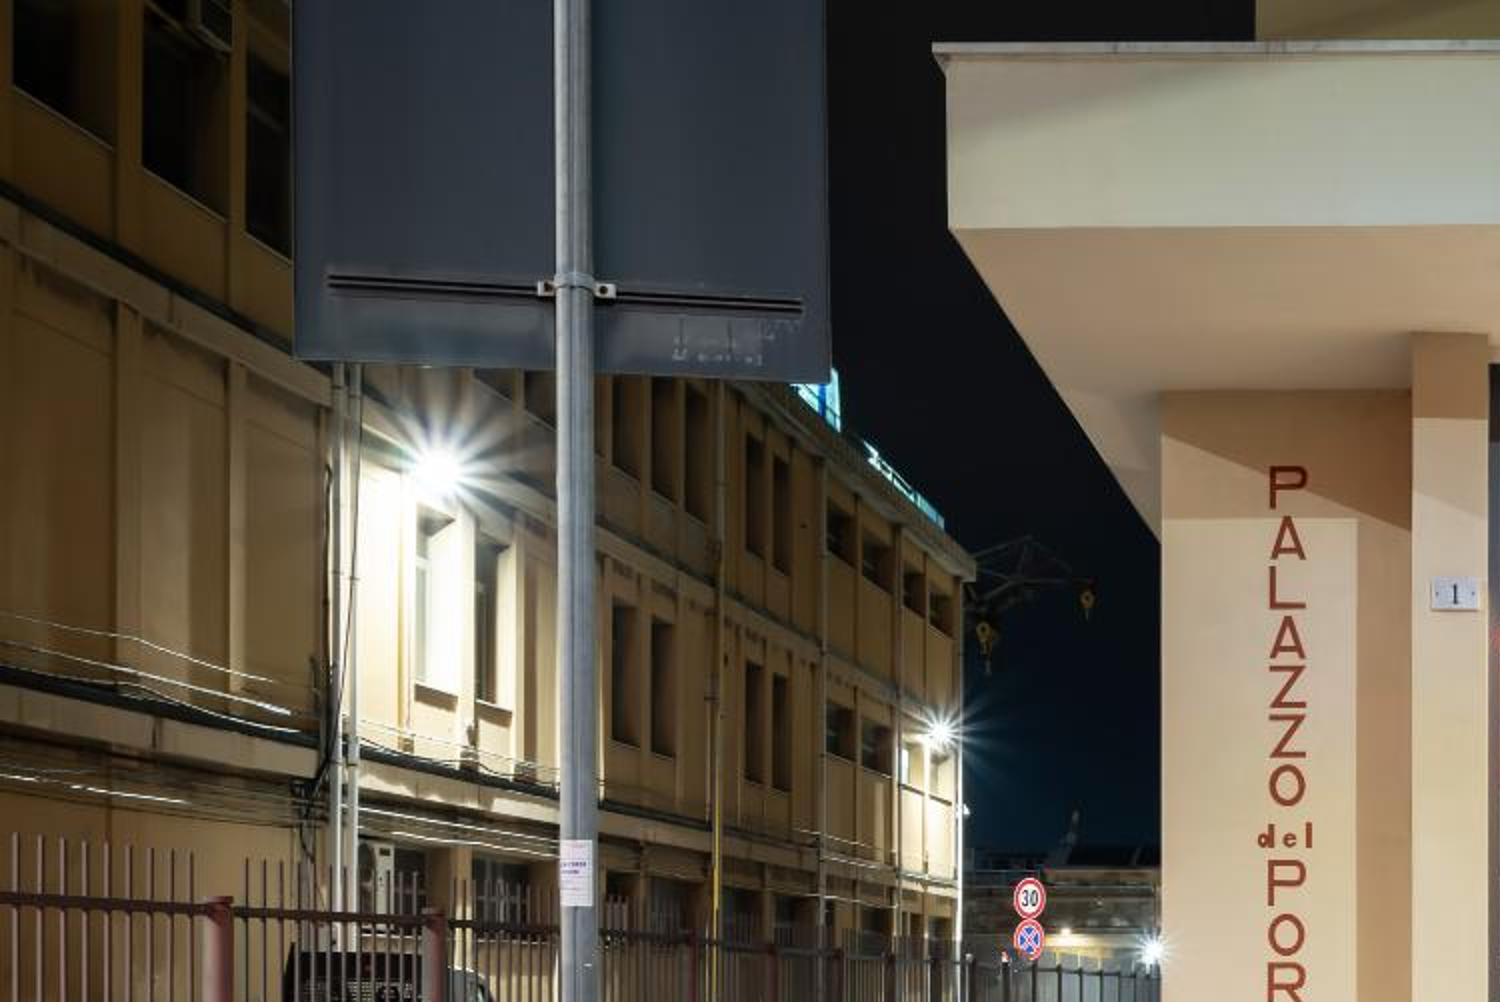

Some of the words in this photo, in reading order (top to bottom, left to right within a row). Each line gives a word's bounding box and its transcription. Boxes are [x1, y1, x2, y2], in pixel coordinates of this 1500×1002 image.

[1268, 465, 1308, 807] PALAZZO
[1257, 821, 1313, 849] del
[1021, 889, 1039, 907] 30
